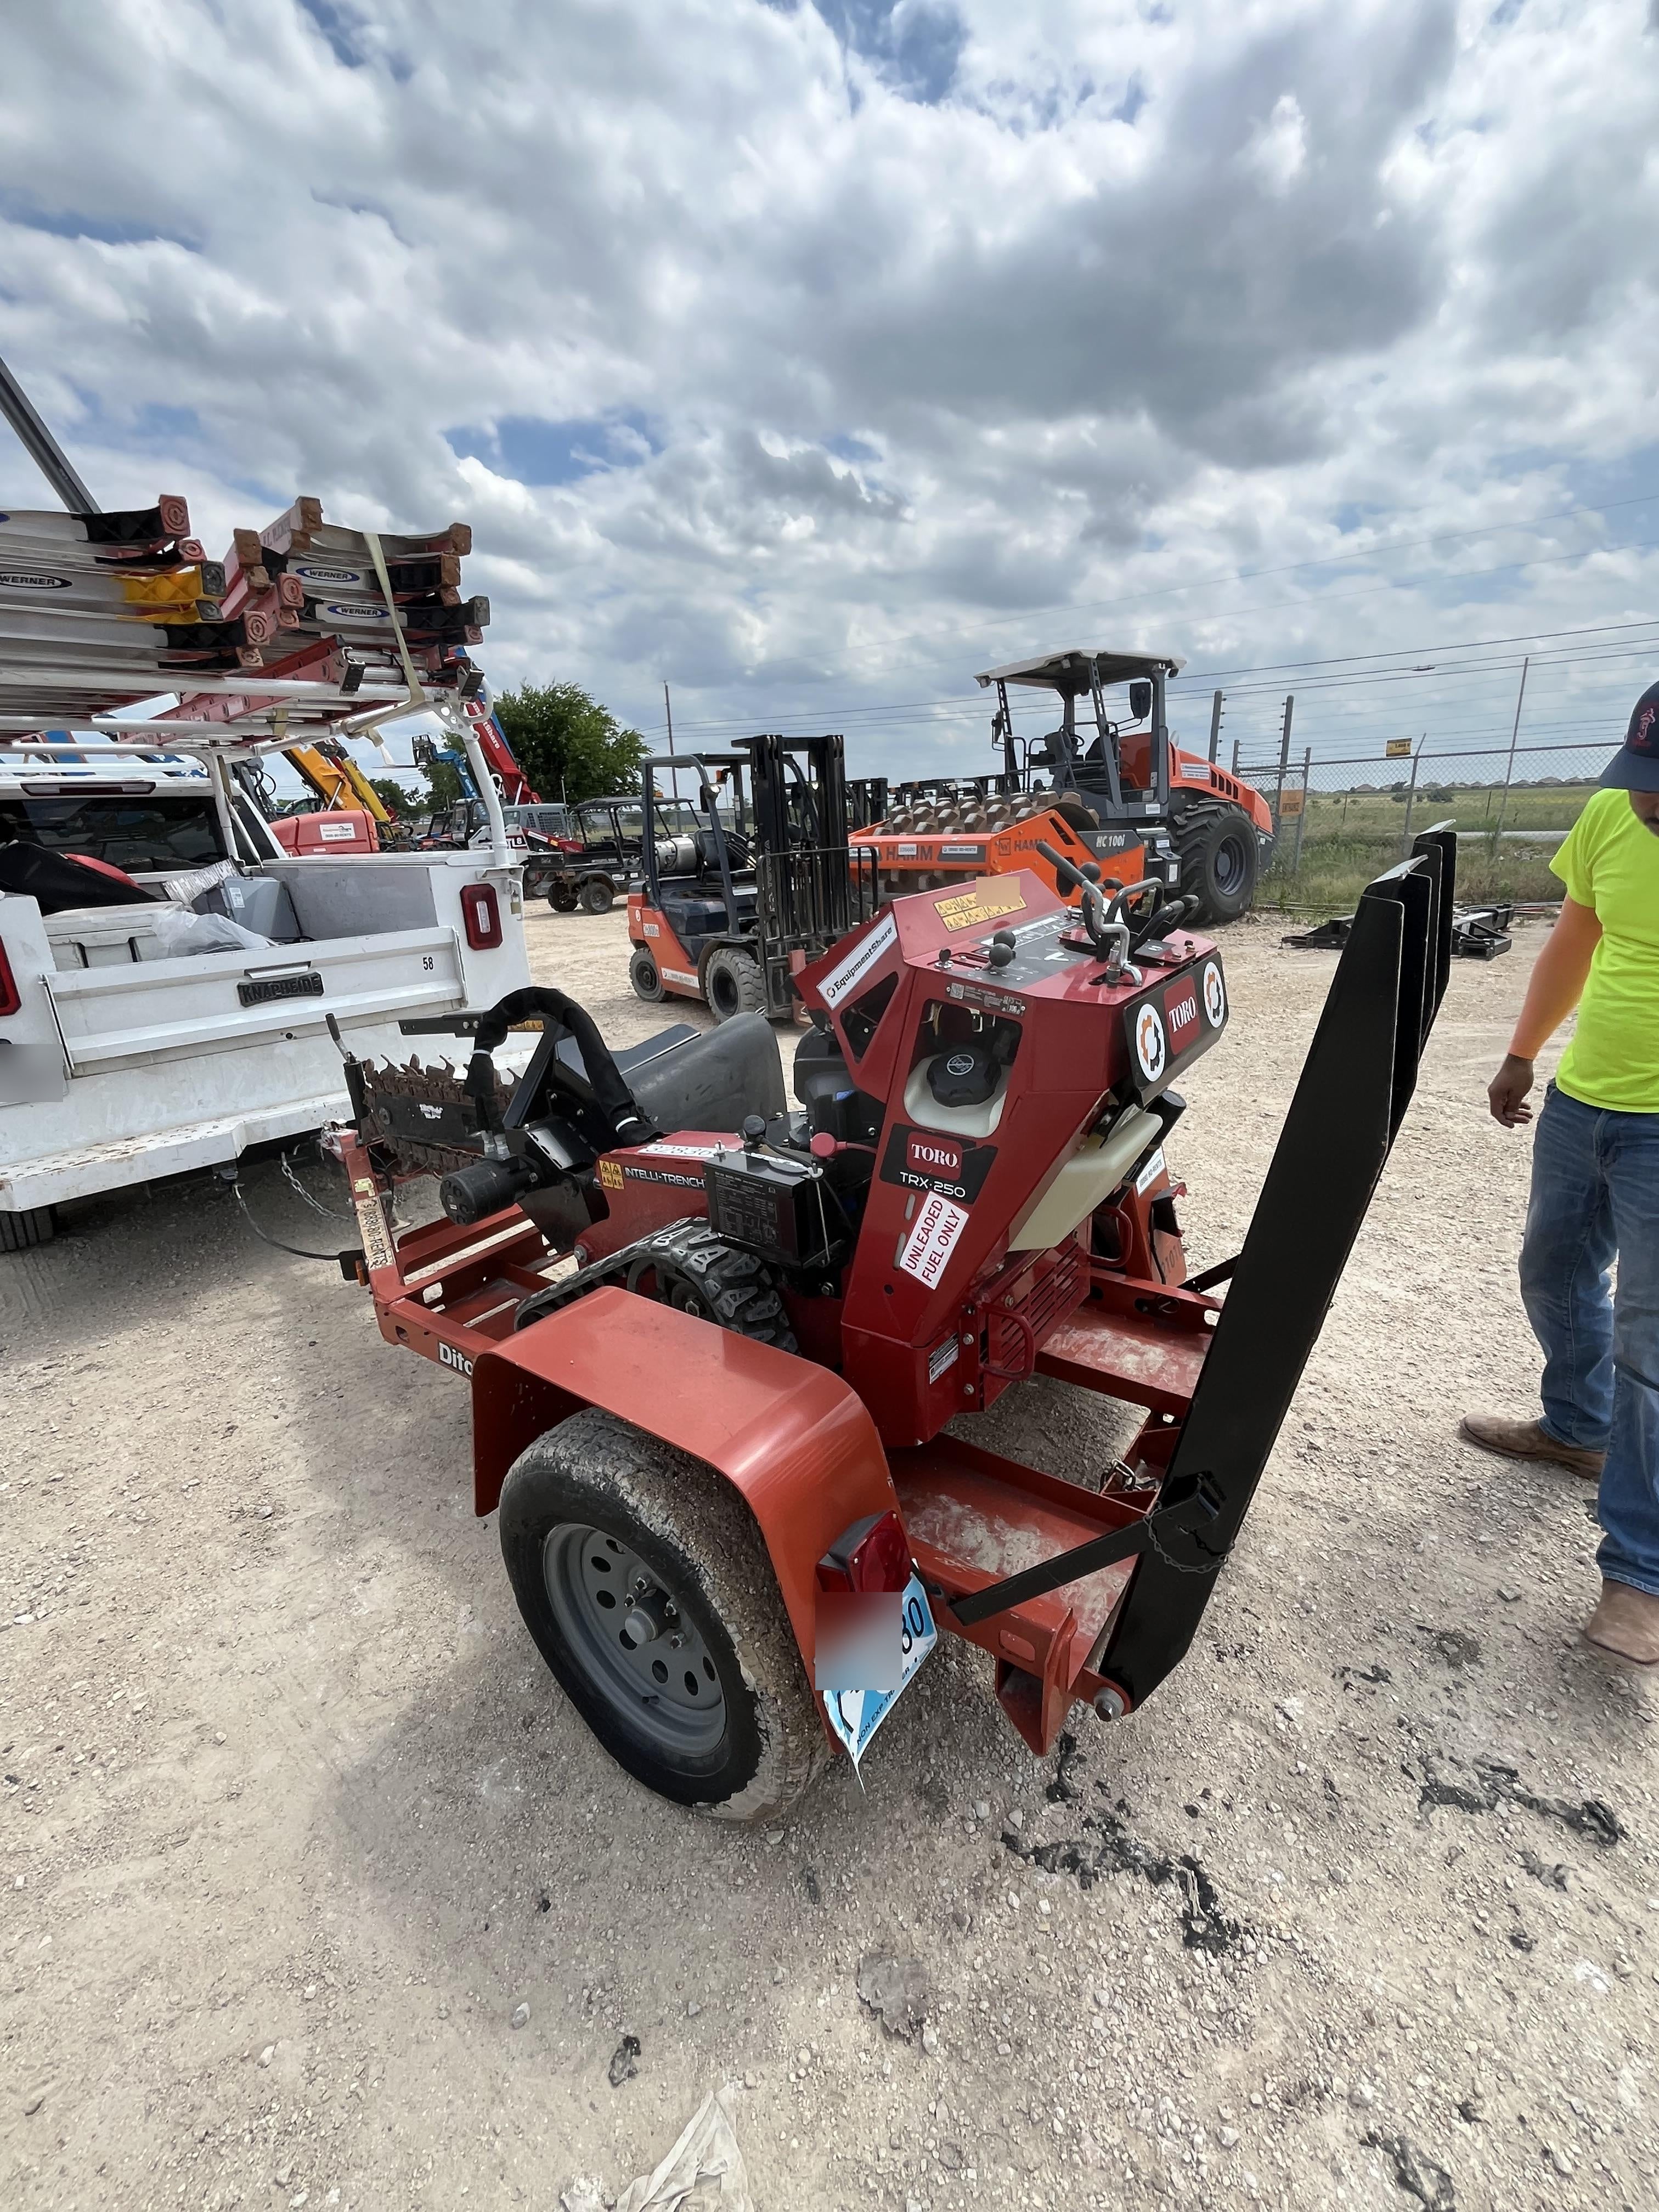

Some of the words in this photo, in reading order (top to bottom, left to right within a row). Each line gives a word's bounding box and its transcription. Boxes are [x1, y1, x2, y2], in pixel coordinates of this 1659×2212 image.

[1, 575, 55, 585] WERNER
[310, 570, 348, 579] WERNER
[341, 607, 377, 616] WERNER
[1014, 838, 1047, 851] HAM
[1096, 836, 1106, 848] HC
[423, 957, 434, 970] 58
[834, 927, 893, 991] EquipmentShare
[244, 975, 320, 1003] KNAPHEIDE
[1169, 996, 1197, 1034] TORO
[911, 1143, 958, 1168] TORO
[905, 1199, 943, 1270] UNLEADED
[922, 1250, 944, 1282] FUEL
[938, 1209, 960, 1247] ONLY
[857, 1722, 871, 1746] NON
[871, 1703, 883, 1721] EXP
